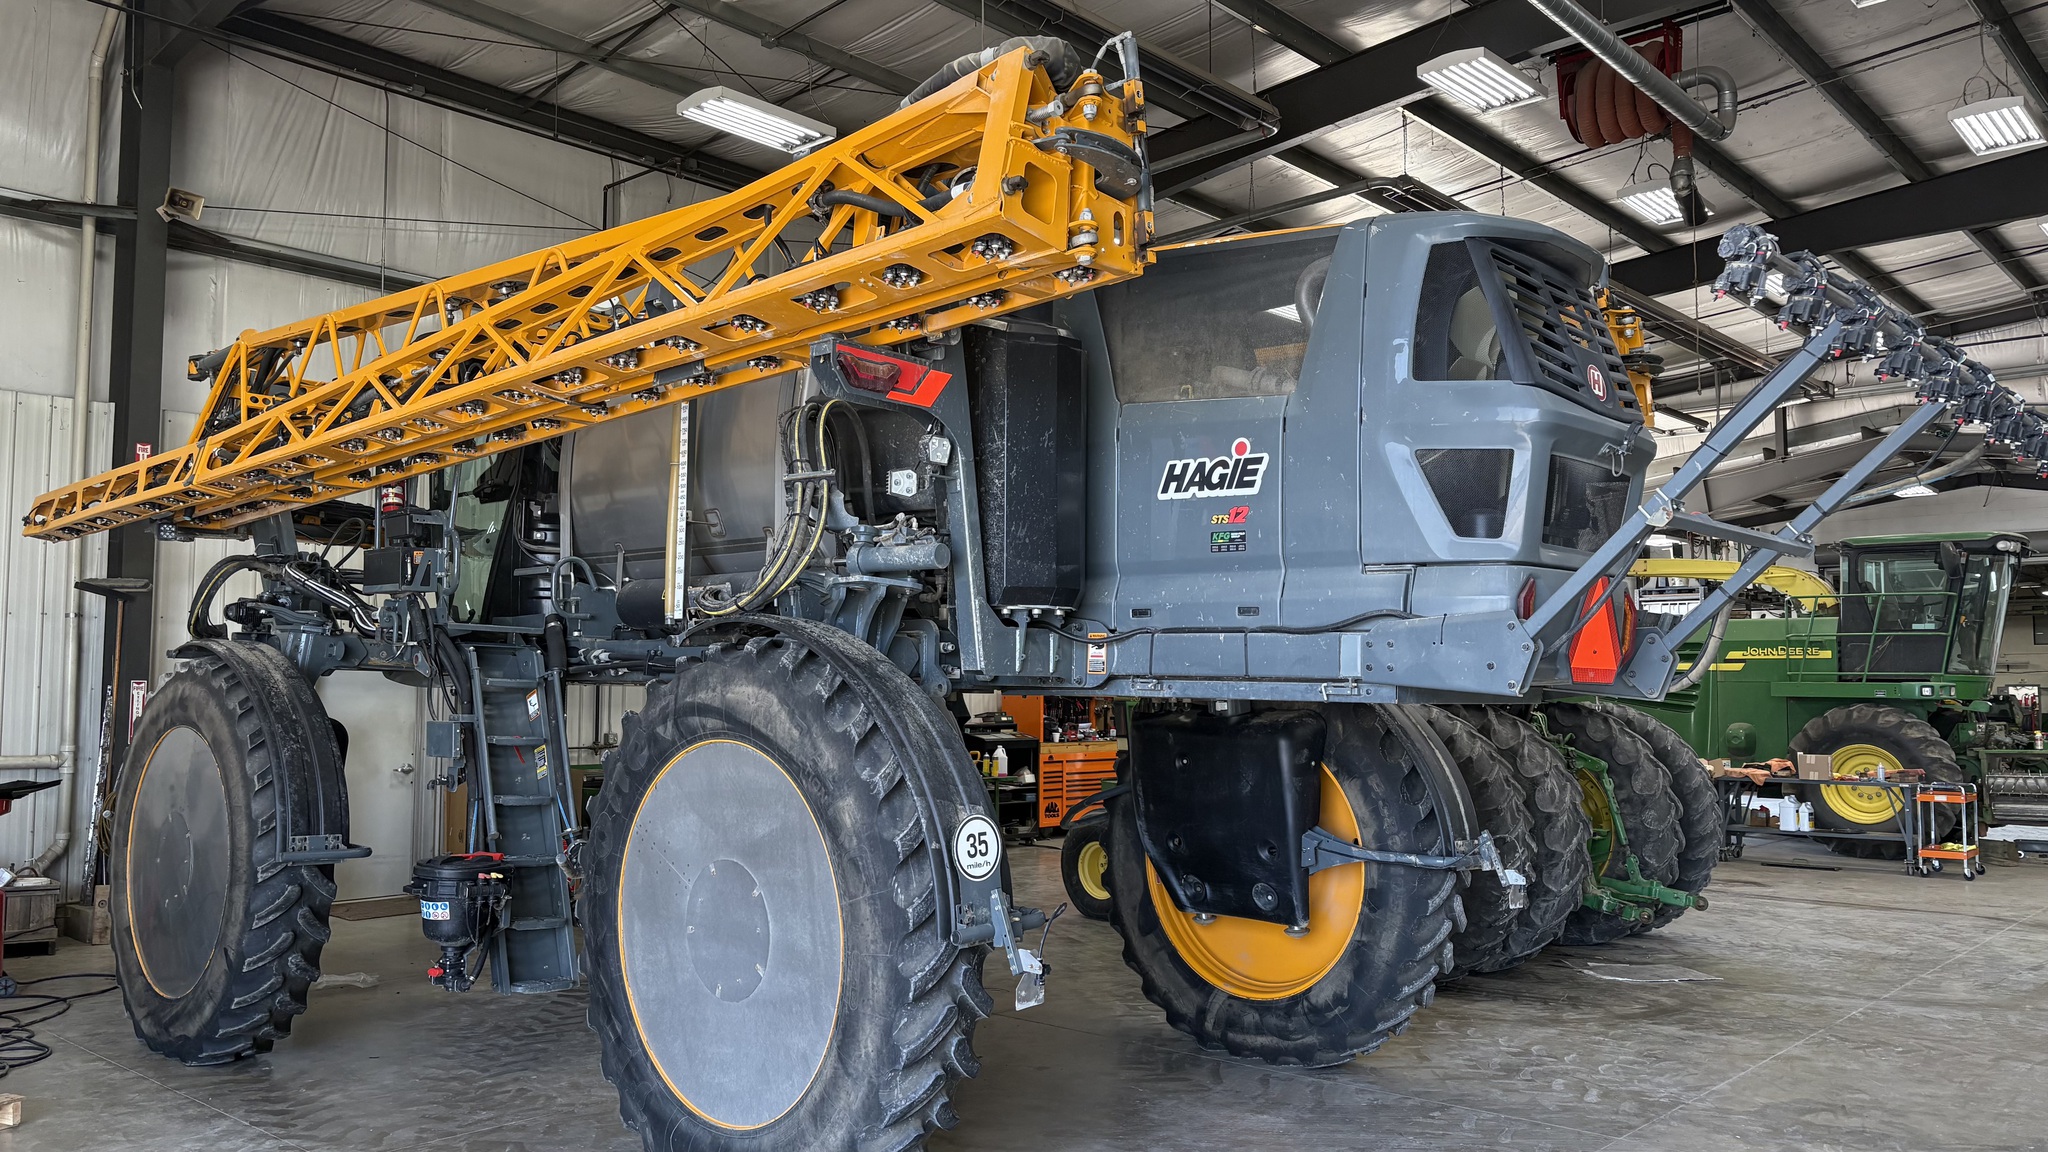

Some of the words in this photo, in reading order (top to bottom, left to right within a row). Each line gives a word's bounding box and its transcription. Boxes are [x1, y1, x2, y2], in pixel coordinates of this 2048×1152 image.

[1159, 439, 1267, 497] HAGIE
[1212, 532, 1230, 541] KFG
[1743, 646, 1776, 656] JOHN
[966, 831, 989, 859] 35
[966, 860, 991, 870] mile/h
